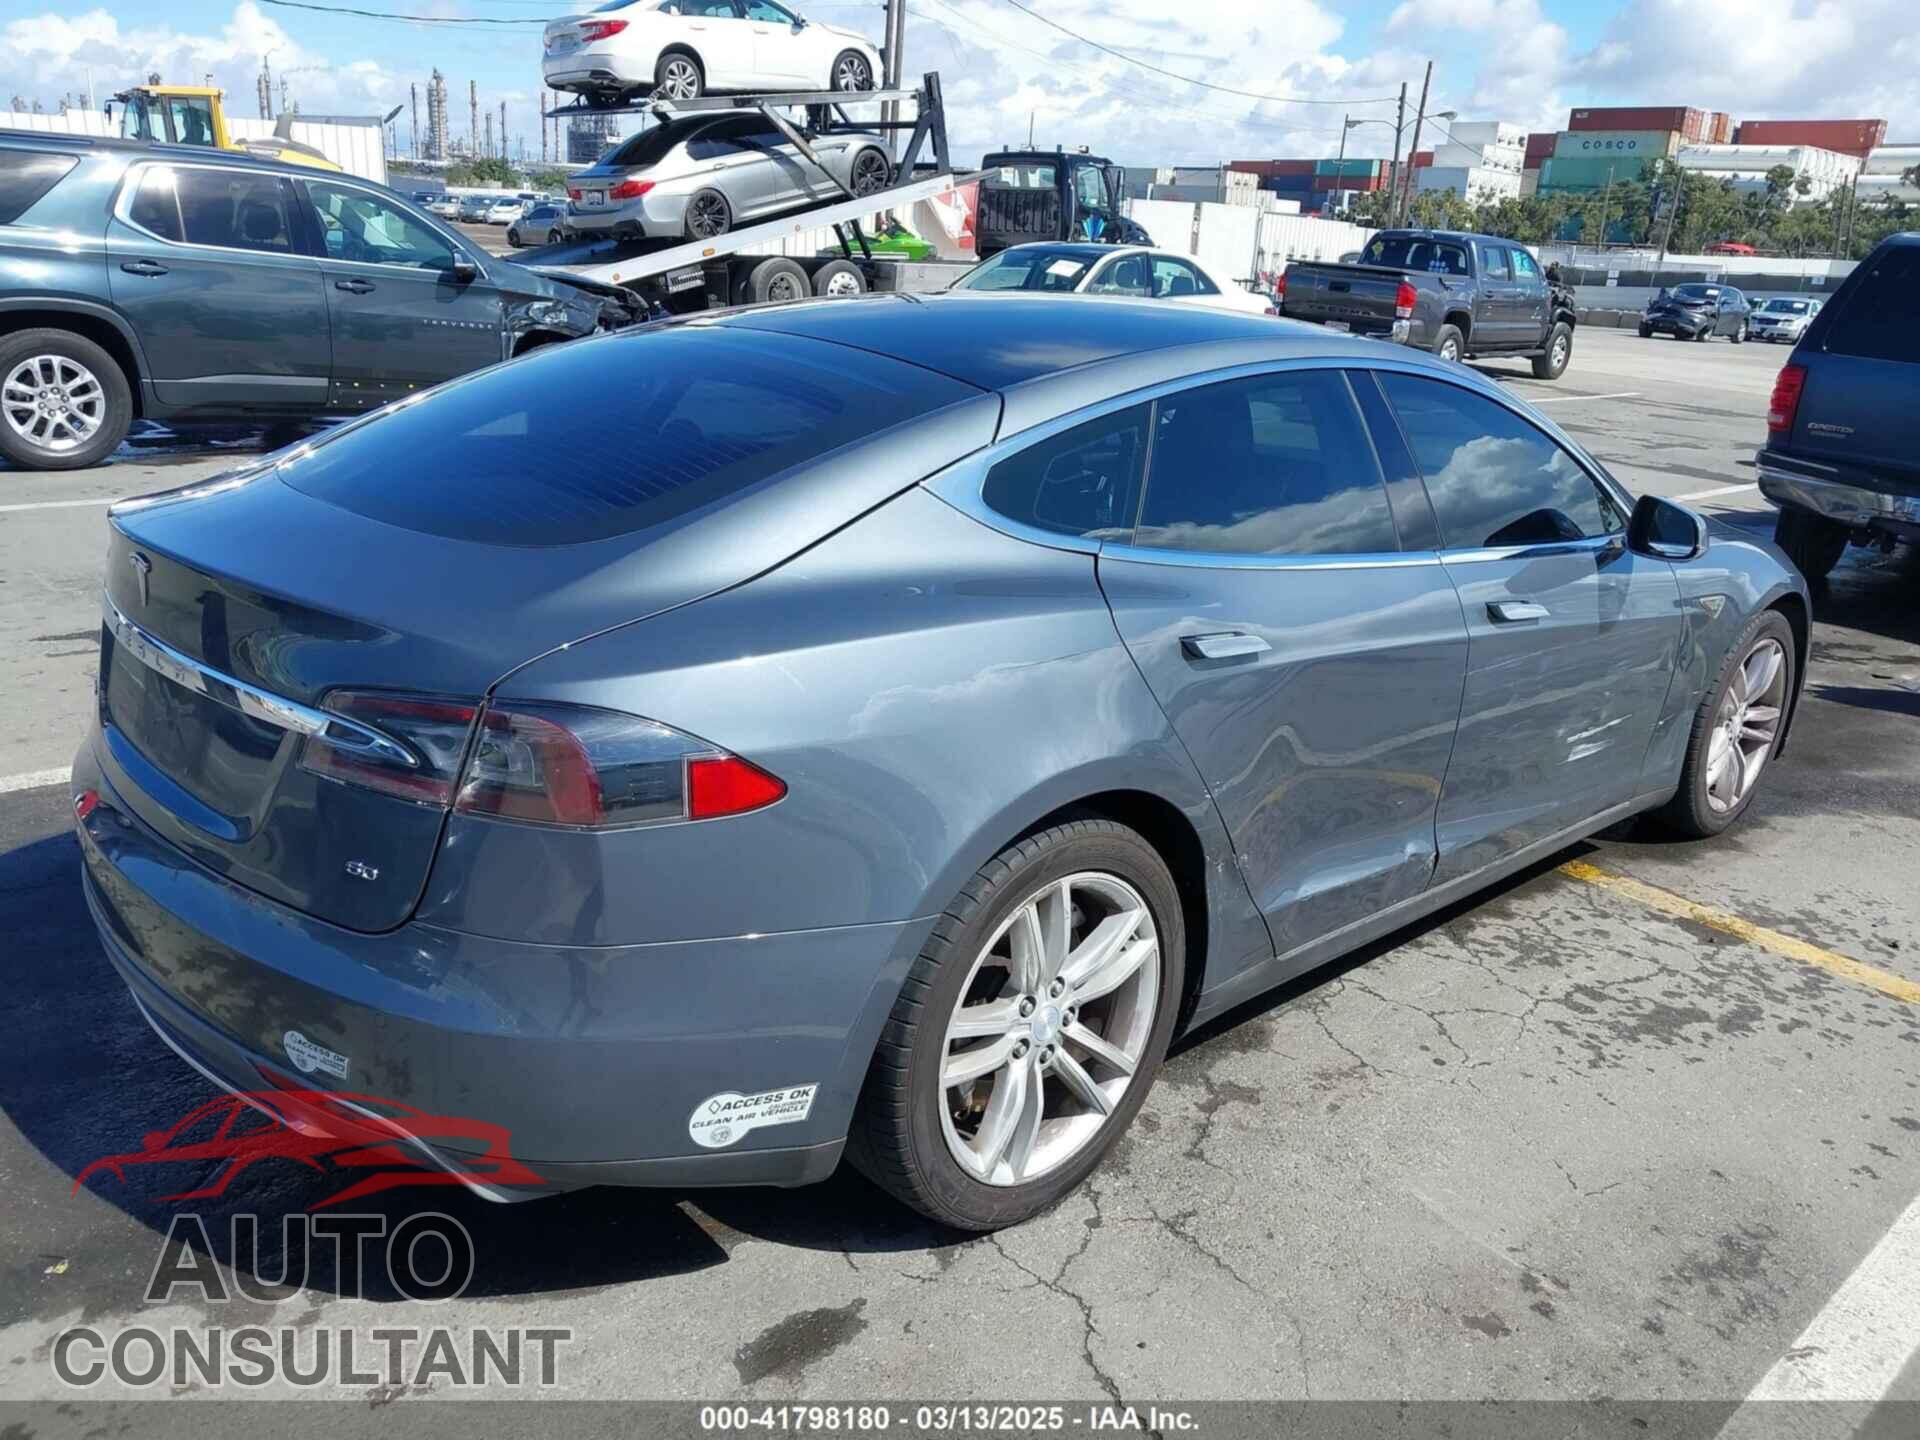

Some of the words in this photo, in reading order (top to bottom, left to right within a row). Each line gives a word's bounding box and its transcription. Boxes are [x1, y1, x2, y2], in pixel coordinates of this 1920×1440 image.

[1582, 140, 1637, 150] COSCO
[113, 620, 187, 683] TESLA
[720, 1092, 785, 1111] ACCESS
[789, 1087, 812, 1100] OK
[691, 1117, 733, 1129] CLEAN
[736, 1112, 757, 1121] AIR
[760, 1103, 807, 1117] VEHICLE
